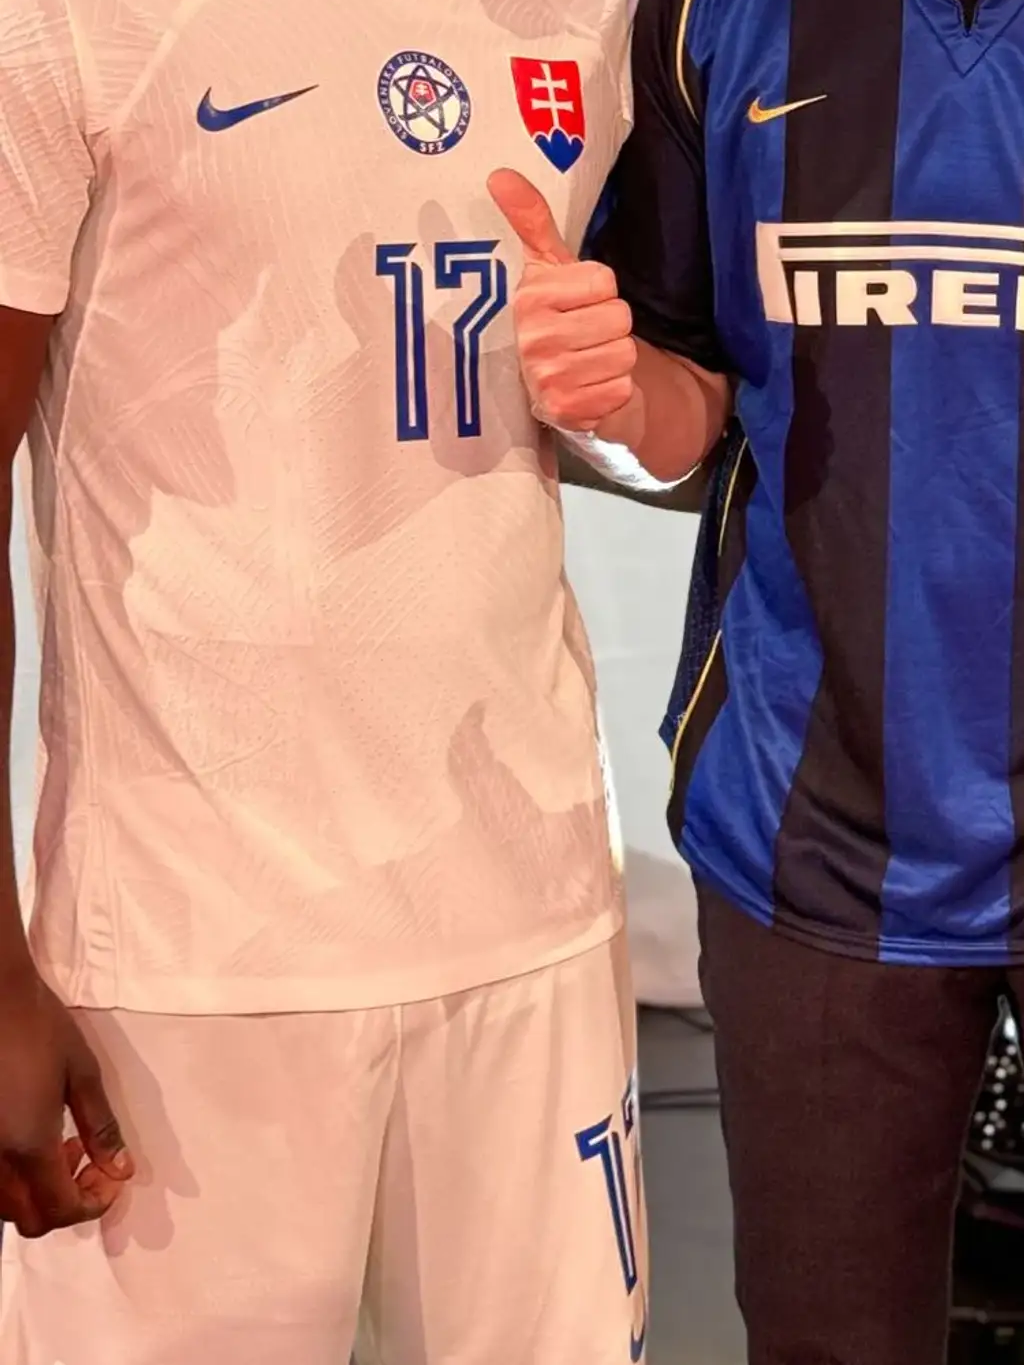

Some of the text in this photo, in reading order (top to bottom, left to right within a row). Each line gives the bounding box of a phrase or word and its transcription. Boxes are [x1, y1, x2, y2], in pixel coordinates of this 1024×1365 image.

[419, 141, 446, 153] SFZ
[376, 239, 508, 442] 17
[575, 1071, 640, 1297] 1
